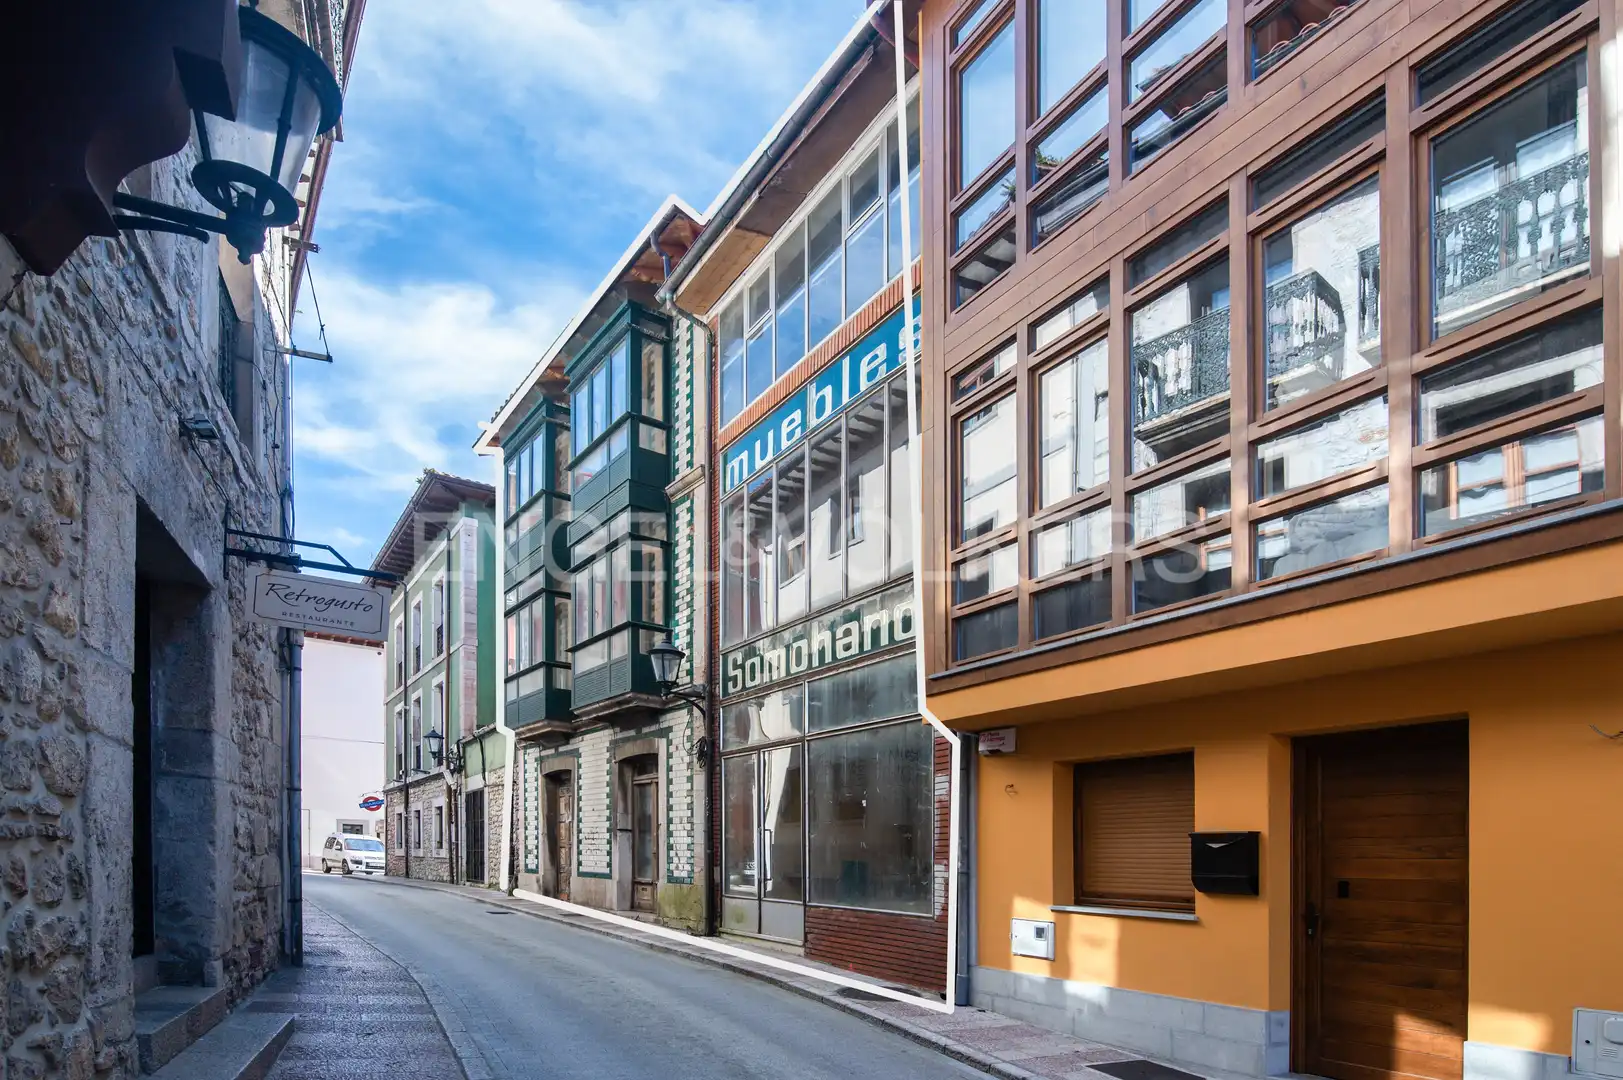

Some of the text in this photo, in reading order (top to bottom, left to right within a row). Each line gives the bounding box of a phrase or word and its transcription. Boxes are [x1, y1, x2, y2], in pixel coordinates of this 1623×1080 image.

[726, 314, 922, 491] muebles
[266, 582, 373, 612] Retrogusto
[281, 612, 356, 627] RESTAURANTE
[727, 602, 916, 693] Somohano
